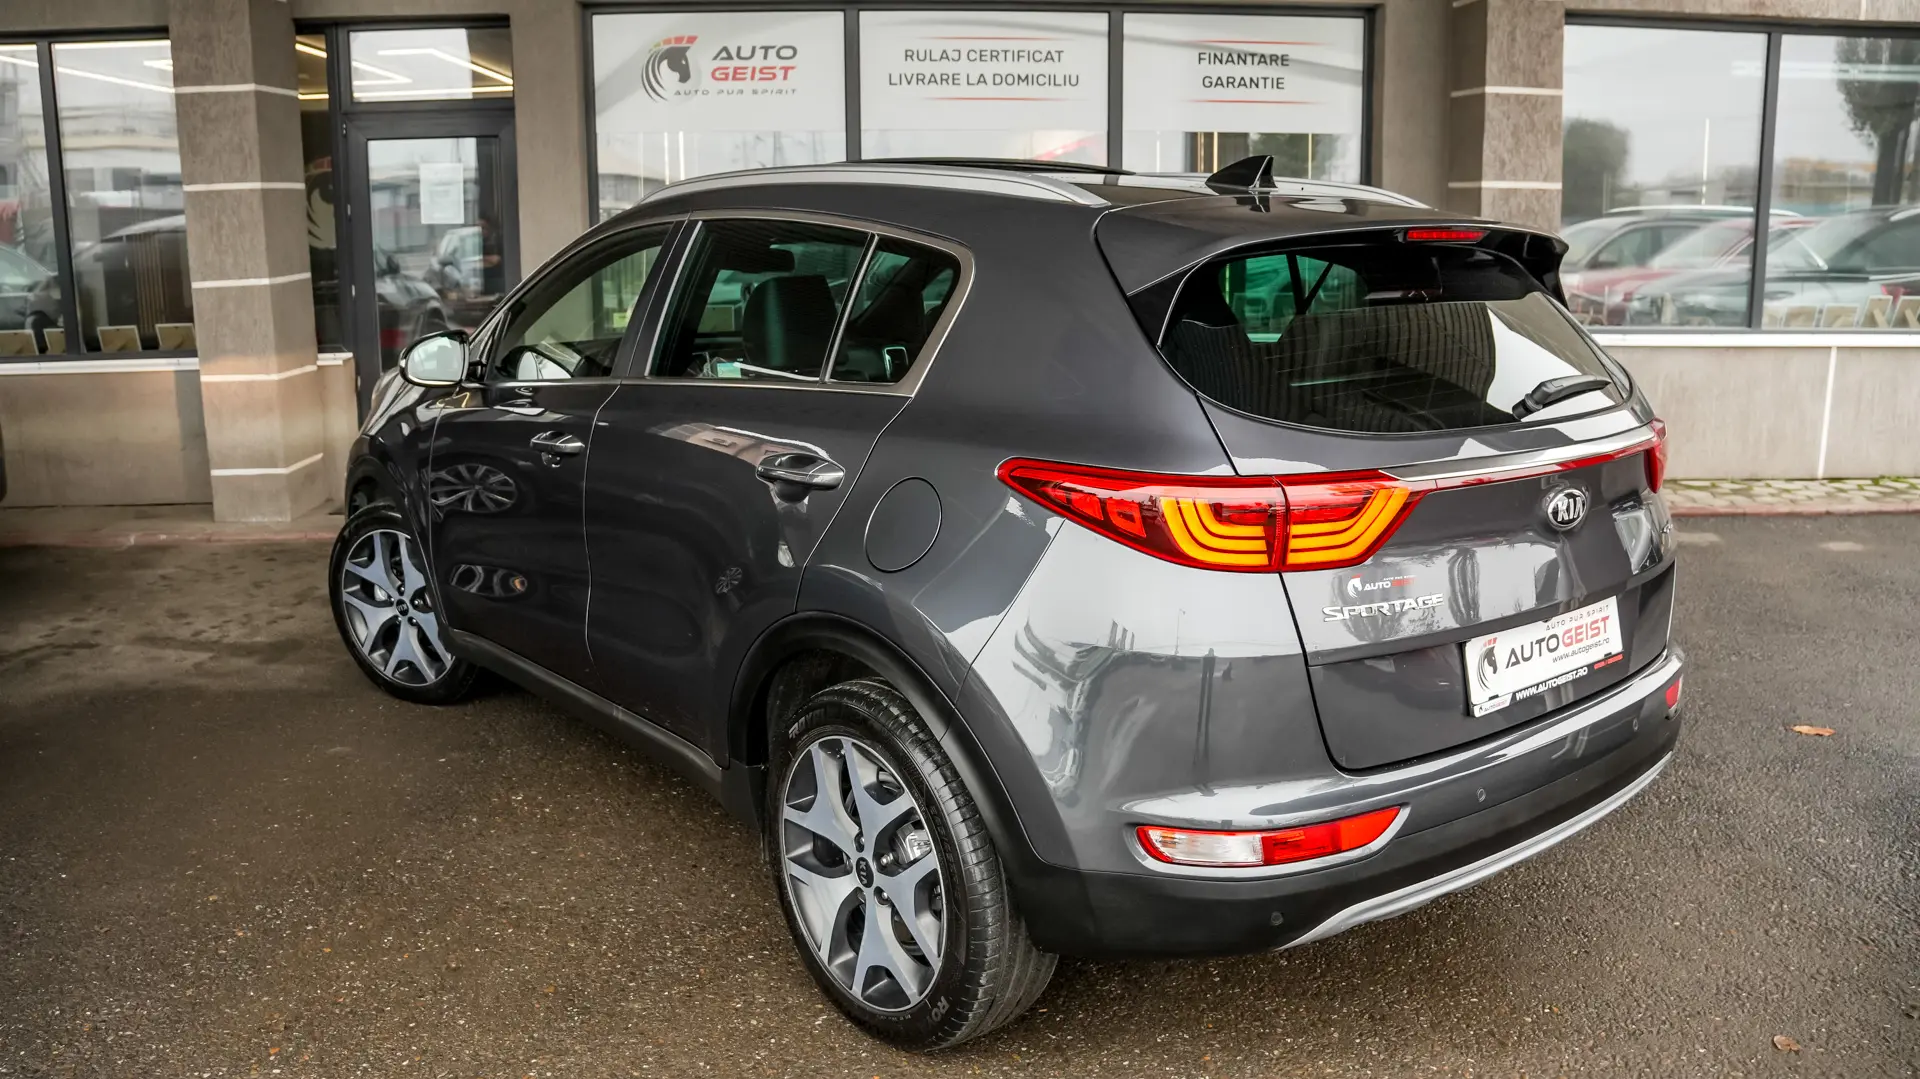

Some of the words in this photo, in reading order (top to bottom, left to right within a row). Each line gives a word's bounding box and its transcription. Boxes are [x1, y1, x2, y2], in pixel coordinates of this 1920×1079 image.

[711, 45, 798, 61] AUTO
[904, 49, 962, 62] RULAJ
[966, 49, 1065, 63] CERTIFICAT
[1198, 52, 1290, 67] FINANTARE
[710, 65, 797, 82] GEIST
[888, 73, 961, 86] LIVRARE
[966, 73, 988, 86] LA
[992, 73, 1080, 87] DOMICILIU
[1202, 75, 1285, 90] GARANTIE
[751, 88, 798, 96] SPIRIT
[1557, 497, 1583, 522] KIA
[1322, 593, 1445, 622] SPORTAGE
[1545, 620, 1566, 631] AUTO
[1569, 613, 1584, 623] PUR
[1505, 615, 1610, 669] AUTOGEIST
[1552, 637, 1610, 664] www.autogeist.ro
[1515, 666, 1589, 701] WWW.AUTOGEIST.RO
[859, 860, 868, 885] KIA
